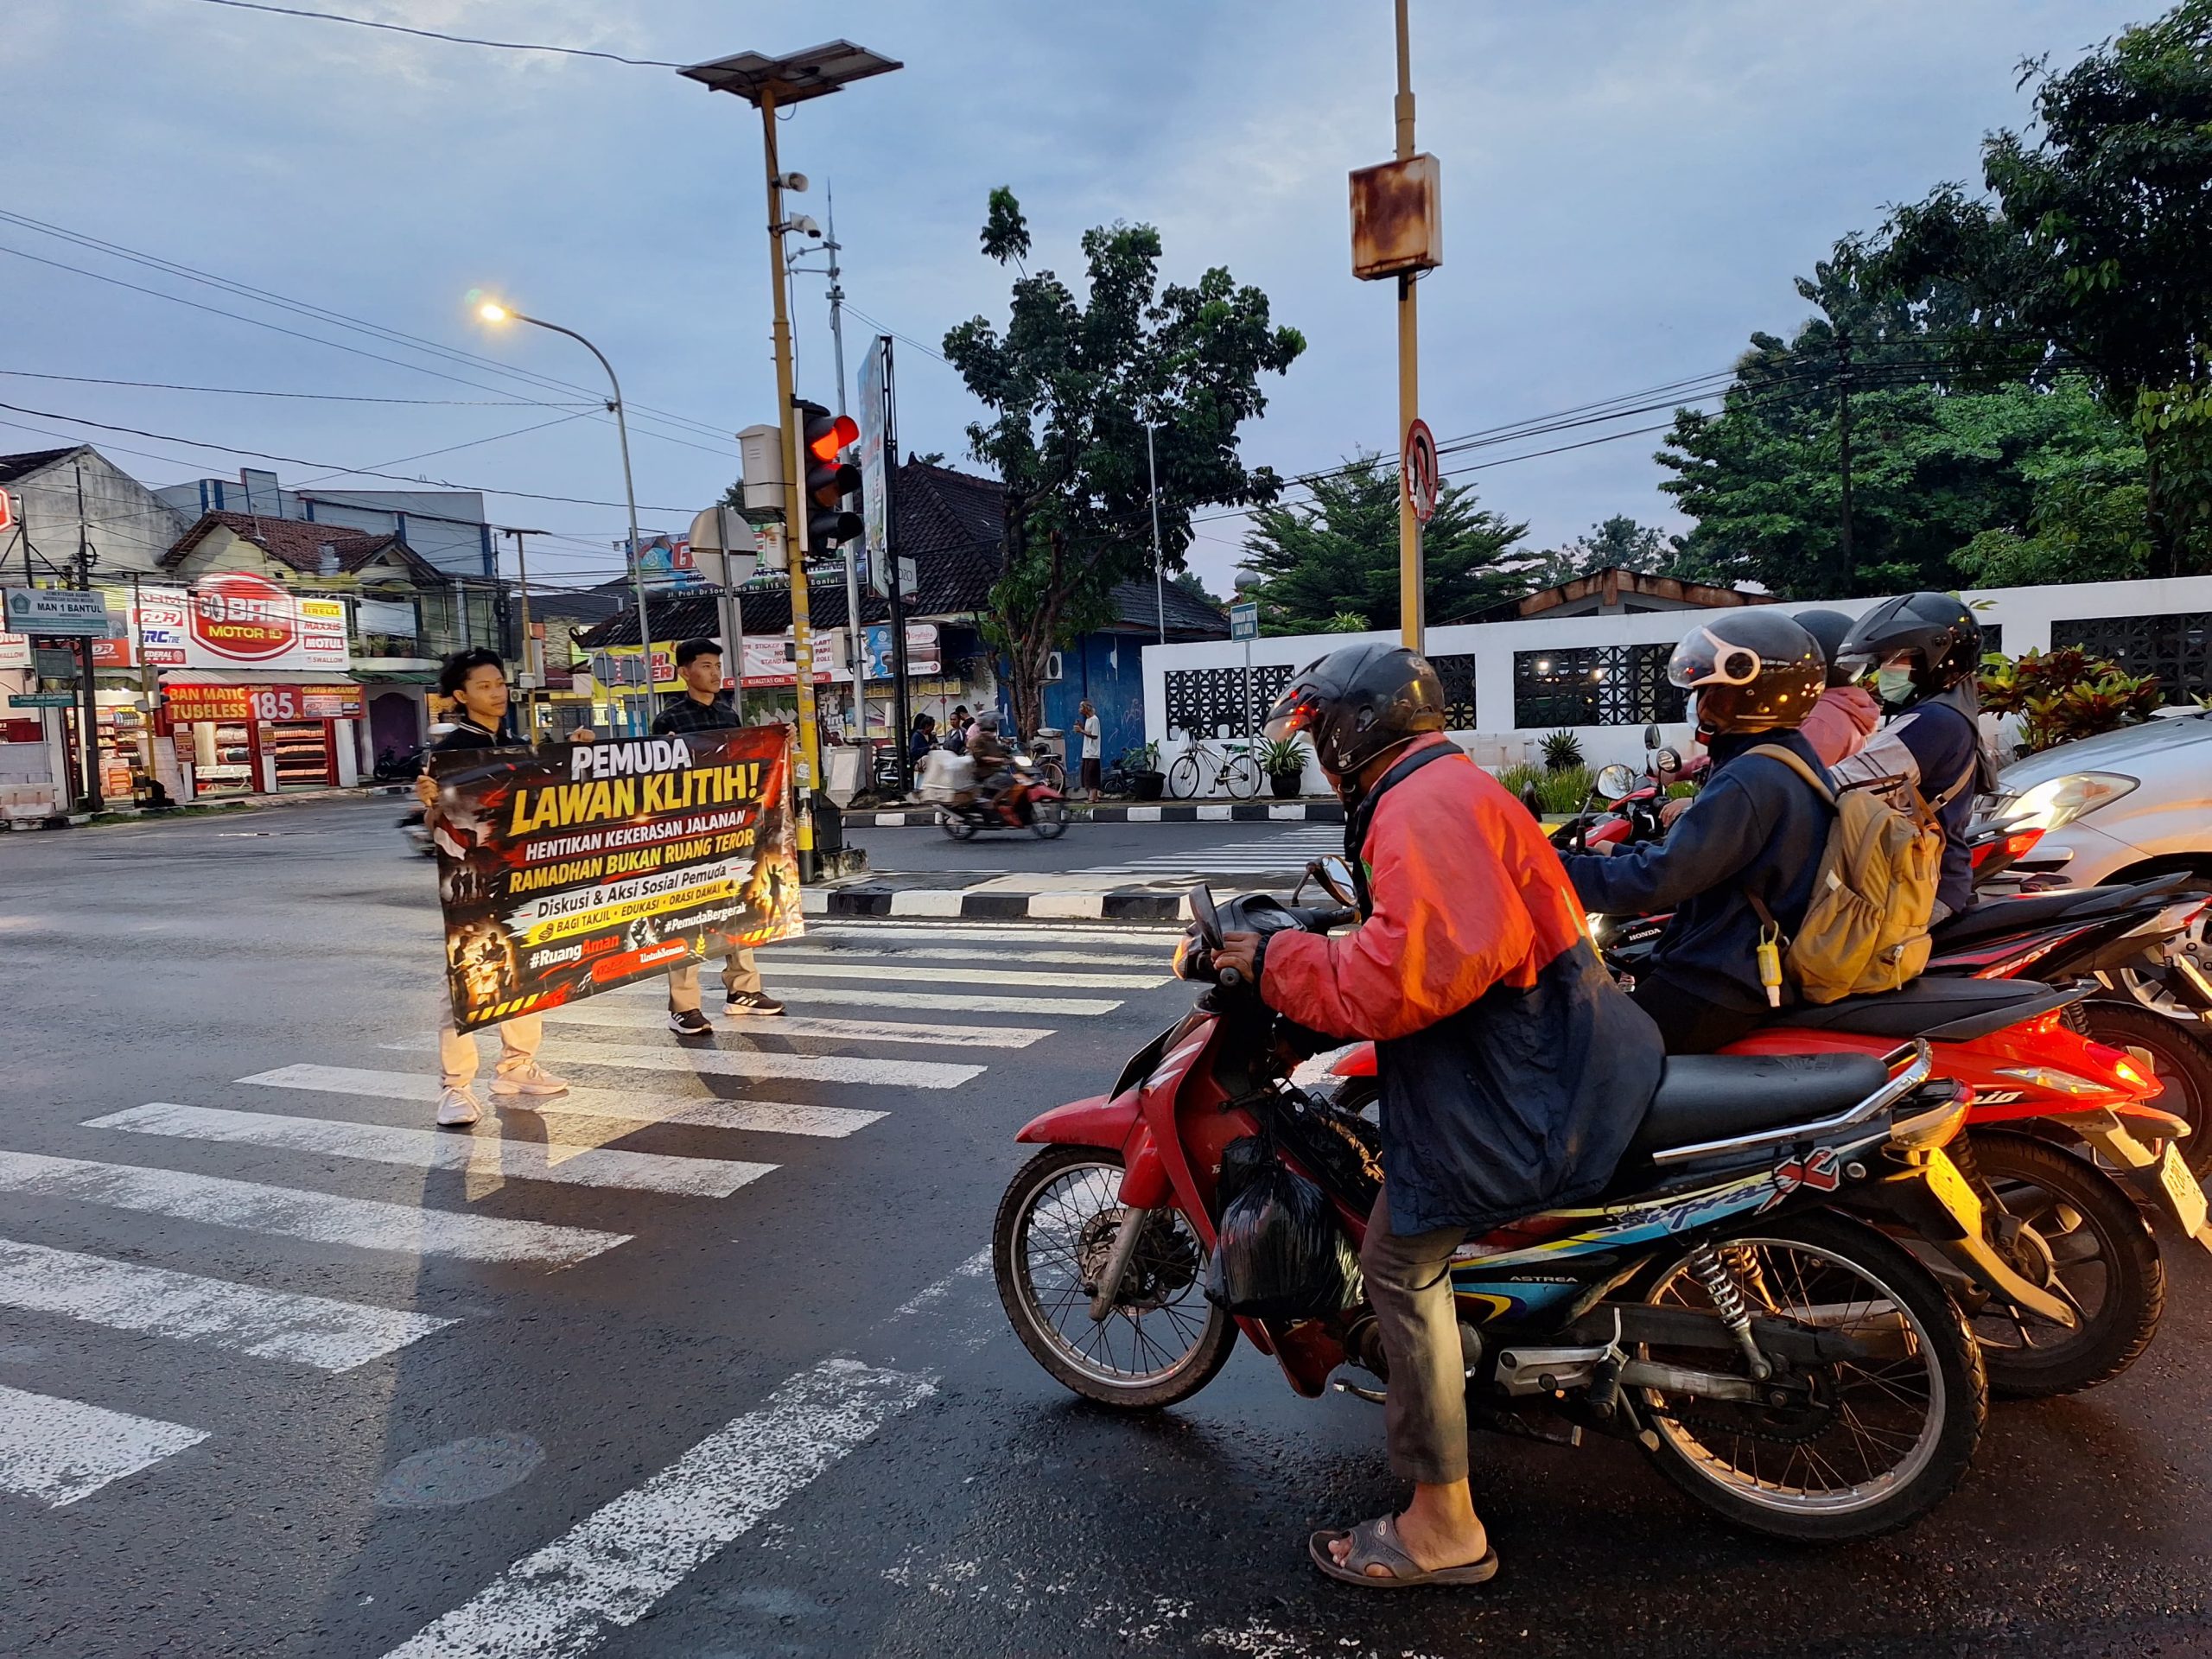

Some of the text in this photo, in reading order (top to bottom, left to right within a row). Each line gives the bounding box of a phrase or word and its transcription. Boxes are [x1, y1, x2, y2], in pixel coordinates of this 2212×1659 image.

[37, 602, 102, 613] MAN 1 BANTUL
[209, 625, 283, 639] MOTOR ID
[305, 638, 343, 650] MOTUL
[169, 688, 201, 701] BAN
[202, 687, 245, 701] MATIC
[249, 692, 294, 720] 185
[169, 703, 247, 720] TUBELESS
[571, 739, 692, 780] PEMUDA
[506, 763, 760, 837] LAWAN KLITIH!
[525, 810, 746, 861] HENTIKAN KEKERASAN JALANAN
[509, 829, 754, 893] RAMADHAN BUKAN RUANG TEROR
[537, 864, 727, 918] Diskusi & Aksi Sosial Pemuda
[556, 884, 721, 933] BAGI TAKJIL EDUKASI ORASI DAMAI
[664, 902, 747, 933] #PemudaBergerak
[1629, 928, 1662, 941] HONDA
[530, 934, 620, 969] #RuangAman
